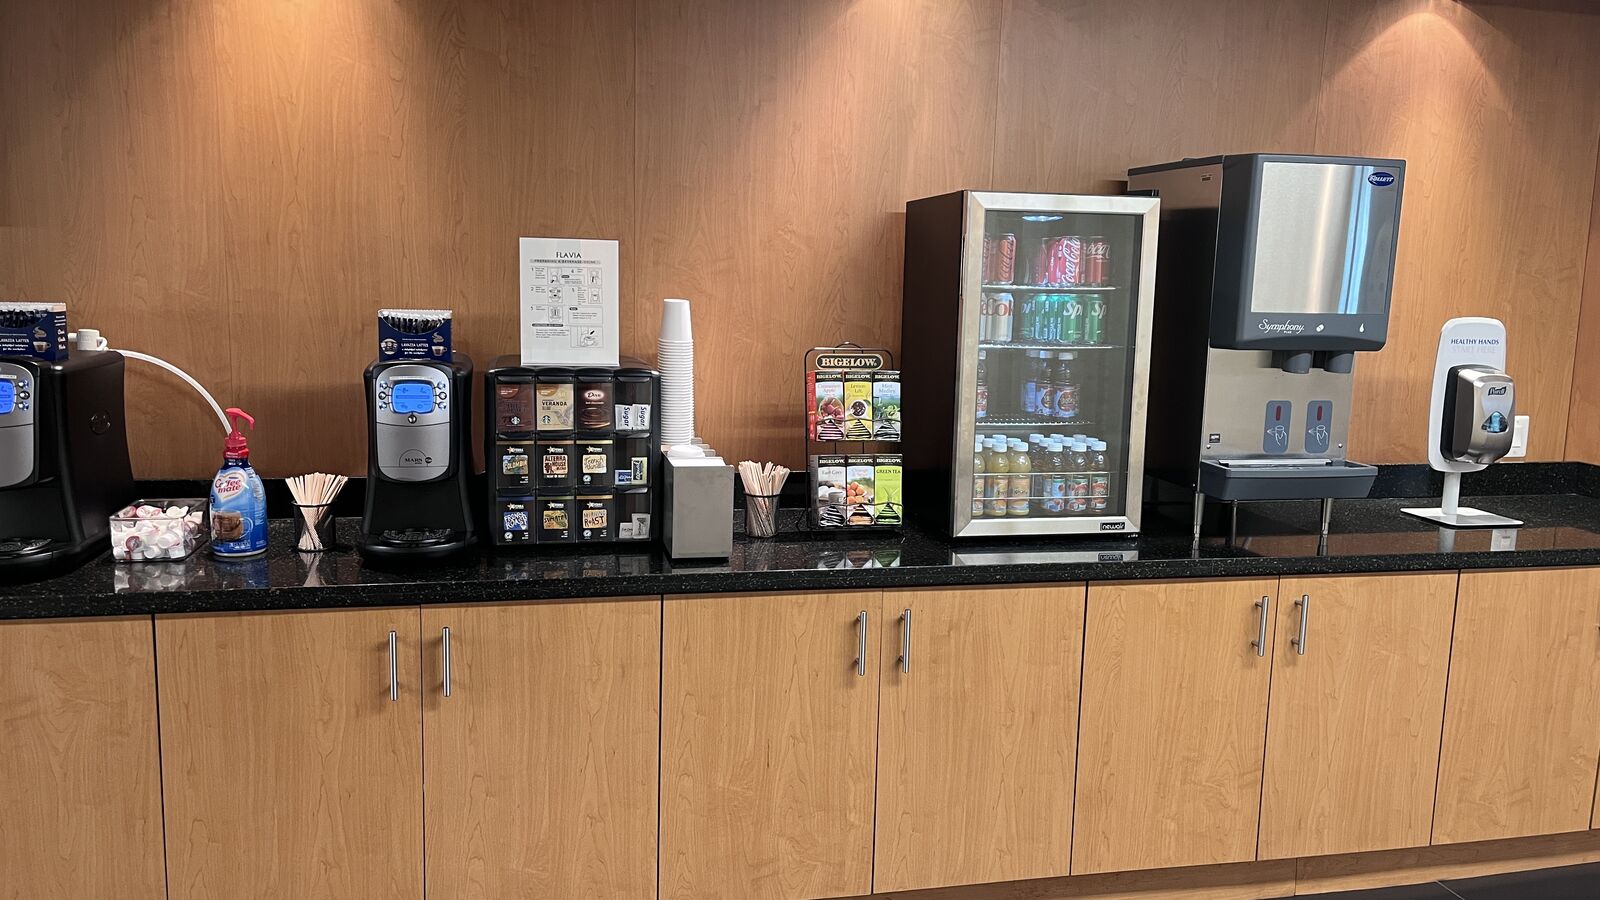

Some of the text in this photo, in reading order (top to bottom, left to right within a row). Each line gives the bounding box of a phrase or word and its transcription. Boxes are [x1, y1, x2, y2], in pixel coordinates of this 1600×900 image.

[556, 251, 582, 259] FLAVIA
[1258, 318, 1305, 335] Symphony
[820, 357, 877, 367] BIGELOW
[623, 406, 631, 427] Sugar
[639, 406, 647, 427] Sugar
[215, 478, 242, 489] Cfee
[218, 484, 242, 494] mate
[584, 515, 605, 528] ROAST
